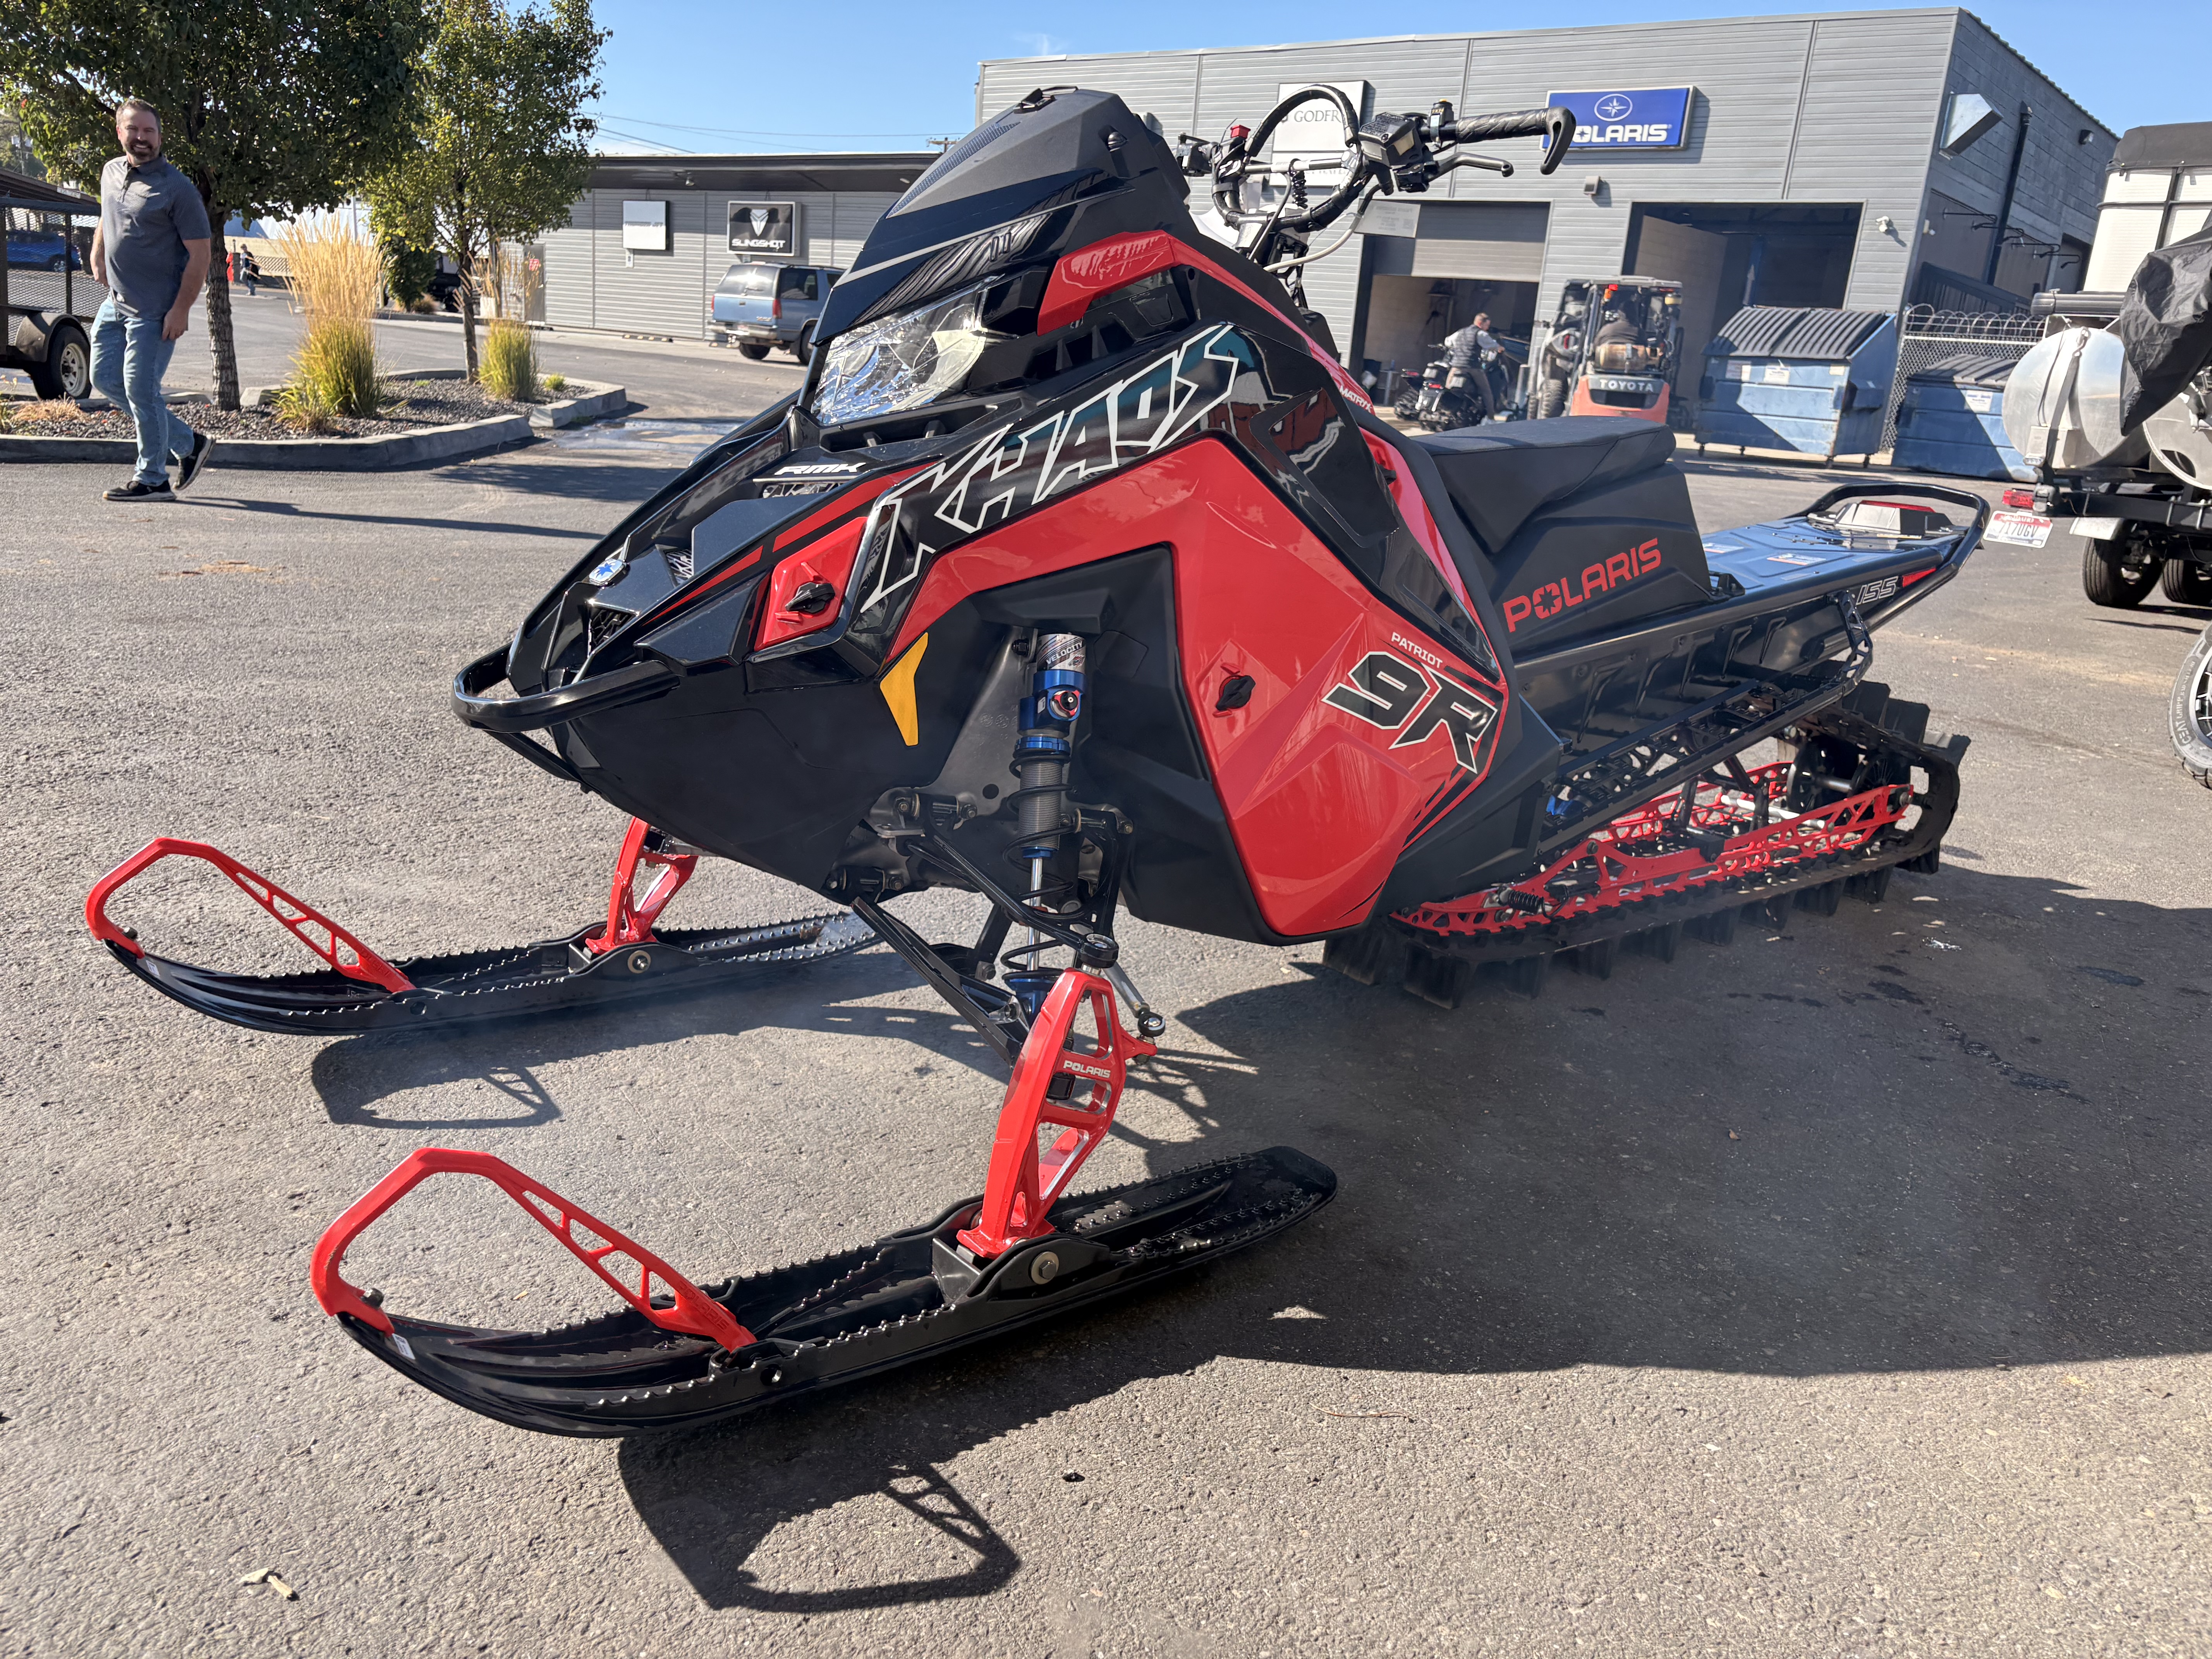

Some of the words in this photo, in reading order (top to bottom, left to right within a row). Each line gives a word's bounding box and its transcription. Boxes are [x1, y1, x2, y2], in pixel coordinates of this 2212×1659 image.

[1294, 110, 1342, 123] GODFR
[1572, 124, 1668, 143] OLARIS
[732, 239, 785, 248] SLINGSHOT
[1599, 379, 1654, 392] TOYOTA
[1340, 385, 1372, 413] MATRYX
[774, 462, 866, 476] RMK
[1503, 537, 1661, 633] POLARIS
[1856, 575, 1899, 605] 155
[1046, 641, 1083, 665] VELOCITY
[1391, 632, 1443, 669] PATRIOT
[1321, 651, 1498, 774] 9R
[1063, 1060, 1111, 1079] POLARIS
[678, 1281, 730, 1331] POLARIS
